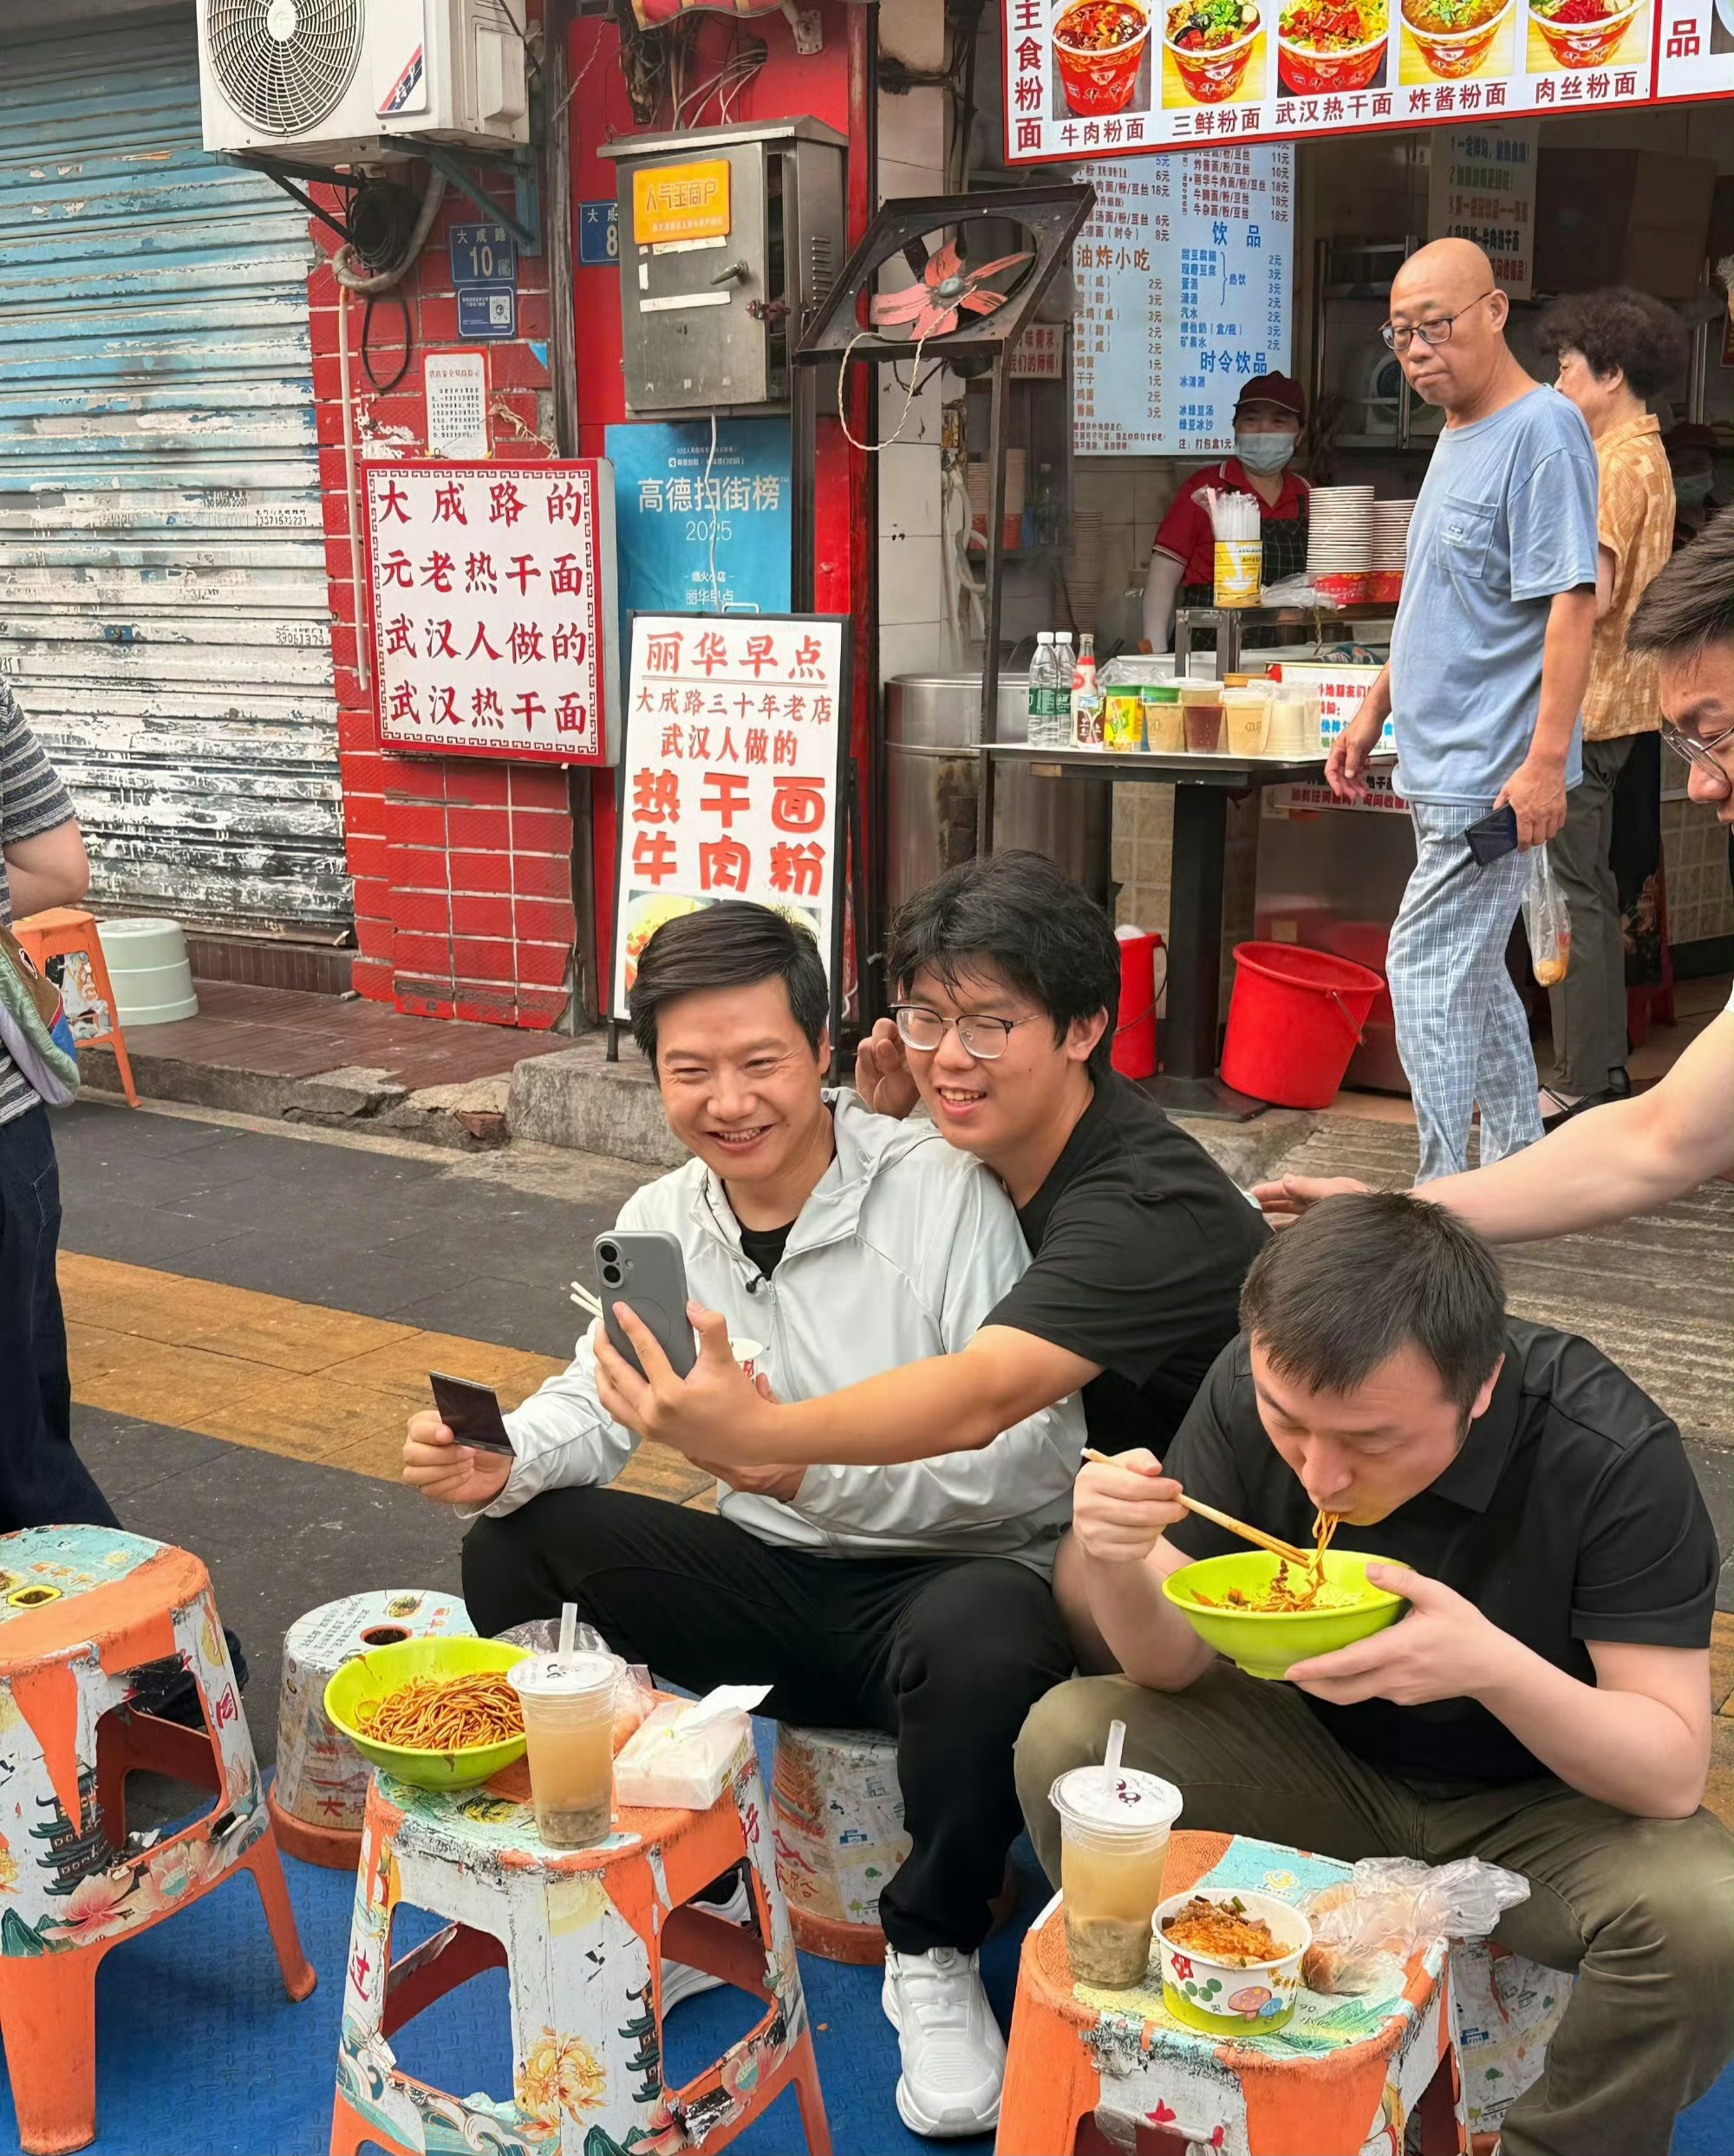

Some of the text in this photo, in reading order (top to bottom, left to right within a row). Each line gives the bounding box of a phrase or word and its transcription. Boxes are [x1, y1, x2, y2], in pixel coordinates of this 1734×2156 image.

[1666, 18, 1700, 59] 品
[1014, 0, 1044, 151] 主食粉面
[1535, 71, 1637, 104] 肉丝粉面
[1275, 92, 1392, 126] 武汉热干面
[1409, 81, 1508, 114] 炸酱粉面
[1060, 117, 1144, 147] 牛肉粉面
[1172, 107, 1260, 136] 三鲜粉面
[607, 225, 618, 257] 8
[1212, 221, 1261, 249] 饮品
[470, 245, 493, 277] 10
[1077, 244, 1151, 272] 油炸小吃
[1200, 350, 1267, 375] 时令饮品
[377, 479, 583, 527] 大成路的
[638, 474, 780, 513] 高德扫街榜
[686, 520, 733, 542] 2025
[381, 549, 583, 596] 元老热干面
[384, 612, 586, 666] 武汉人做的
[645, 631, 826, 681] 丽华早点
[388, 679, 586, 735] 武汉热干面
[635, 687, 832, 726] 大成路三十年老店
[661, 725, 798, 766] 武汉人做的
[632, 768, 826, 833] 热干面
[631, 832, 825, 896] 牛肉粉
